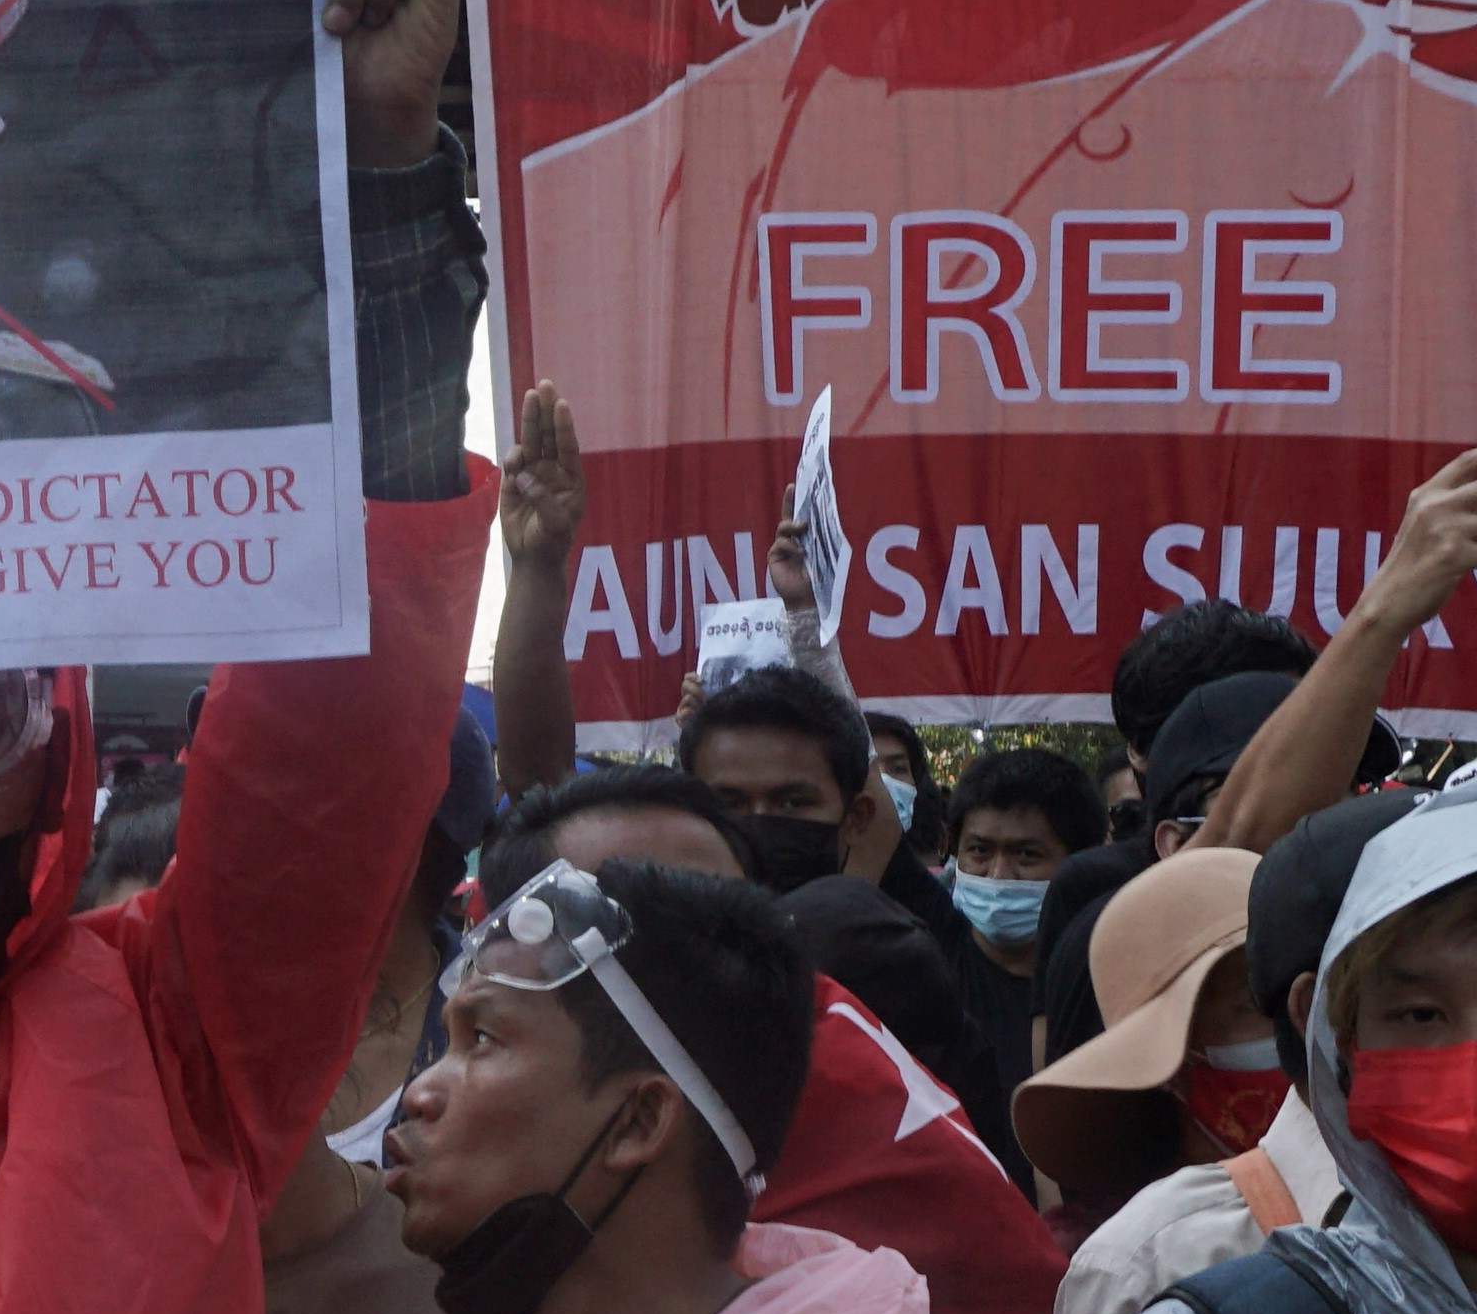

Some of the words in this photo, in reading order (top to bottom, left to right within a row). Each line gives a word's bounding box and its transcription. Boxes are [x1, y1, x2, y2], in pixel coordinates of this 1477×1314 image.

[755, 209, 1345, 407] FREE
[139, 535, 281, 589] YOU
[865, 523, 1101, 641] SAN
